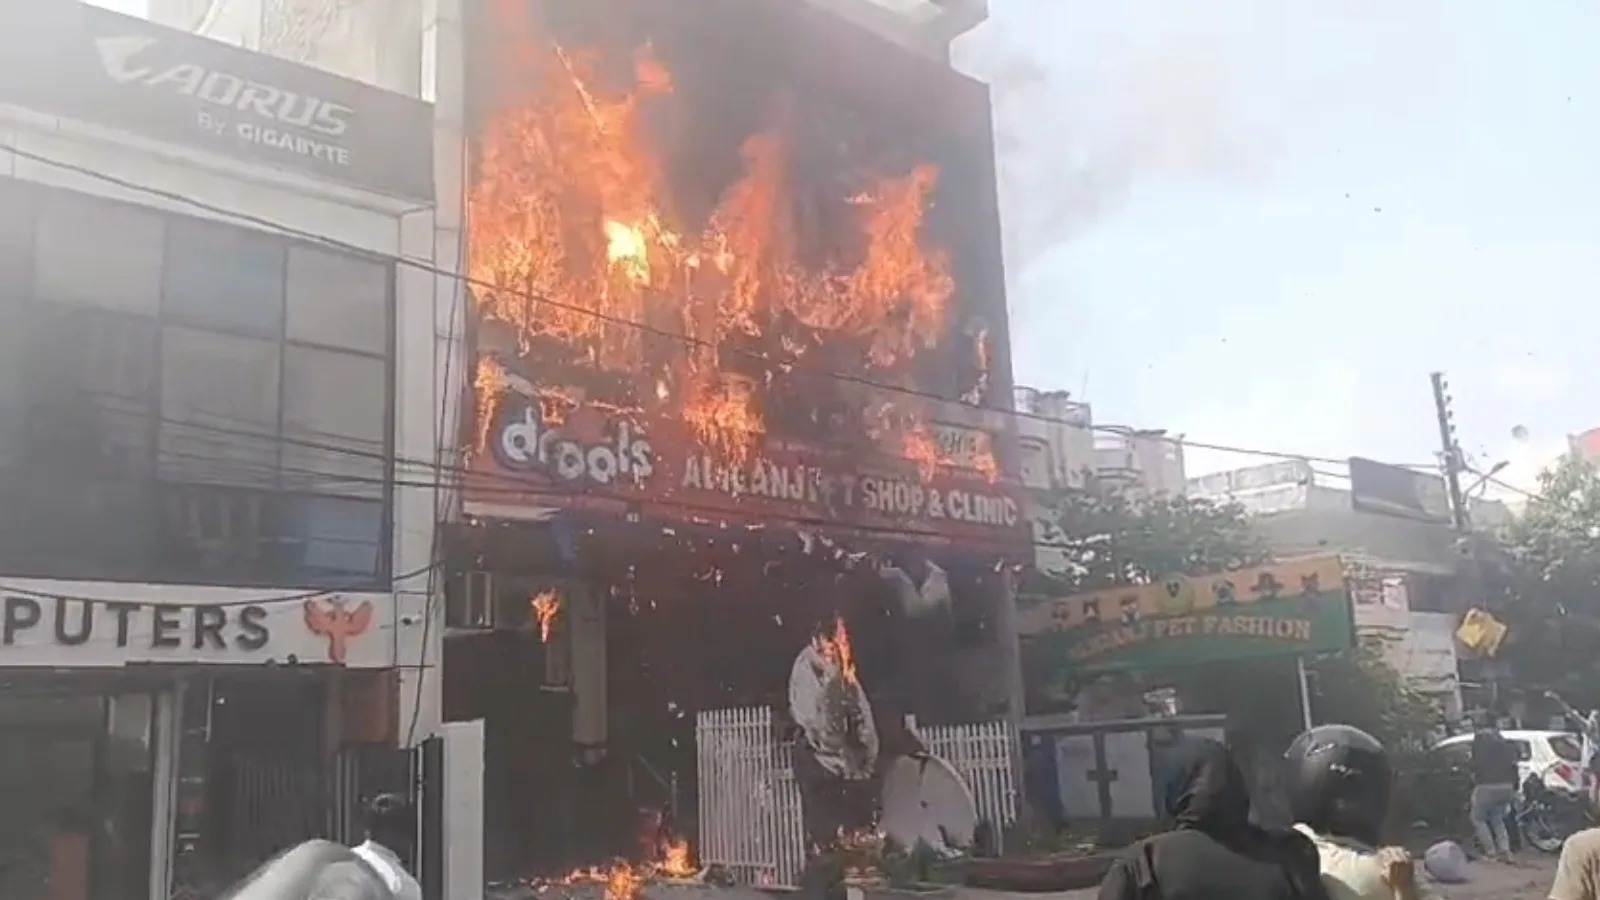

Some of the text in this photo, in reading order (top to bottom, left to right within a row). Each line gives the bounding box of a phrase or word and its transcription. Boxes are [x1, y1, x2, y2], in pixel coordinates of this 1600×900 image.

[147, 62, 356, 136] AORUS
[197, 111, 350, 165] By GIGABYTE
[502, 406, 653, 484] drools
[862, 477, 925, 514] SHOP
[927, 489, 946, 518] &
[948, 490, 1018, 527] CLINIC
[3, 597, 270, 650] PUTERS
[1155, 617, 1198, 638] PET
[1203, 615, 1311, 640] FASHION
